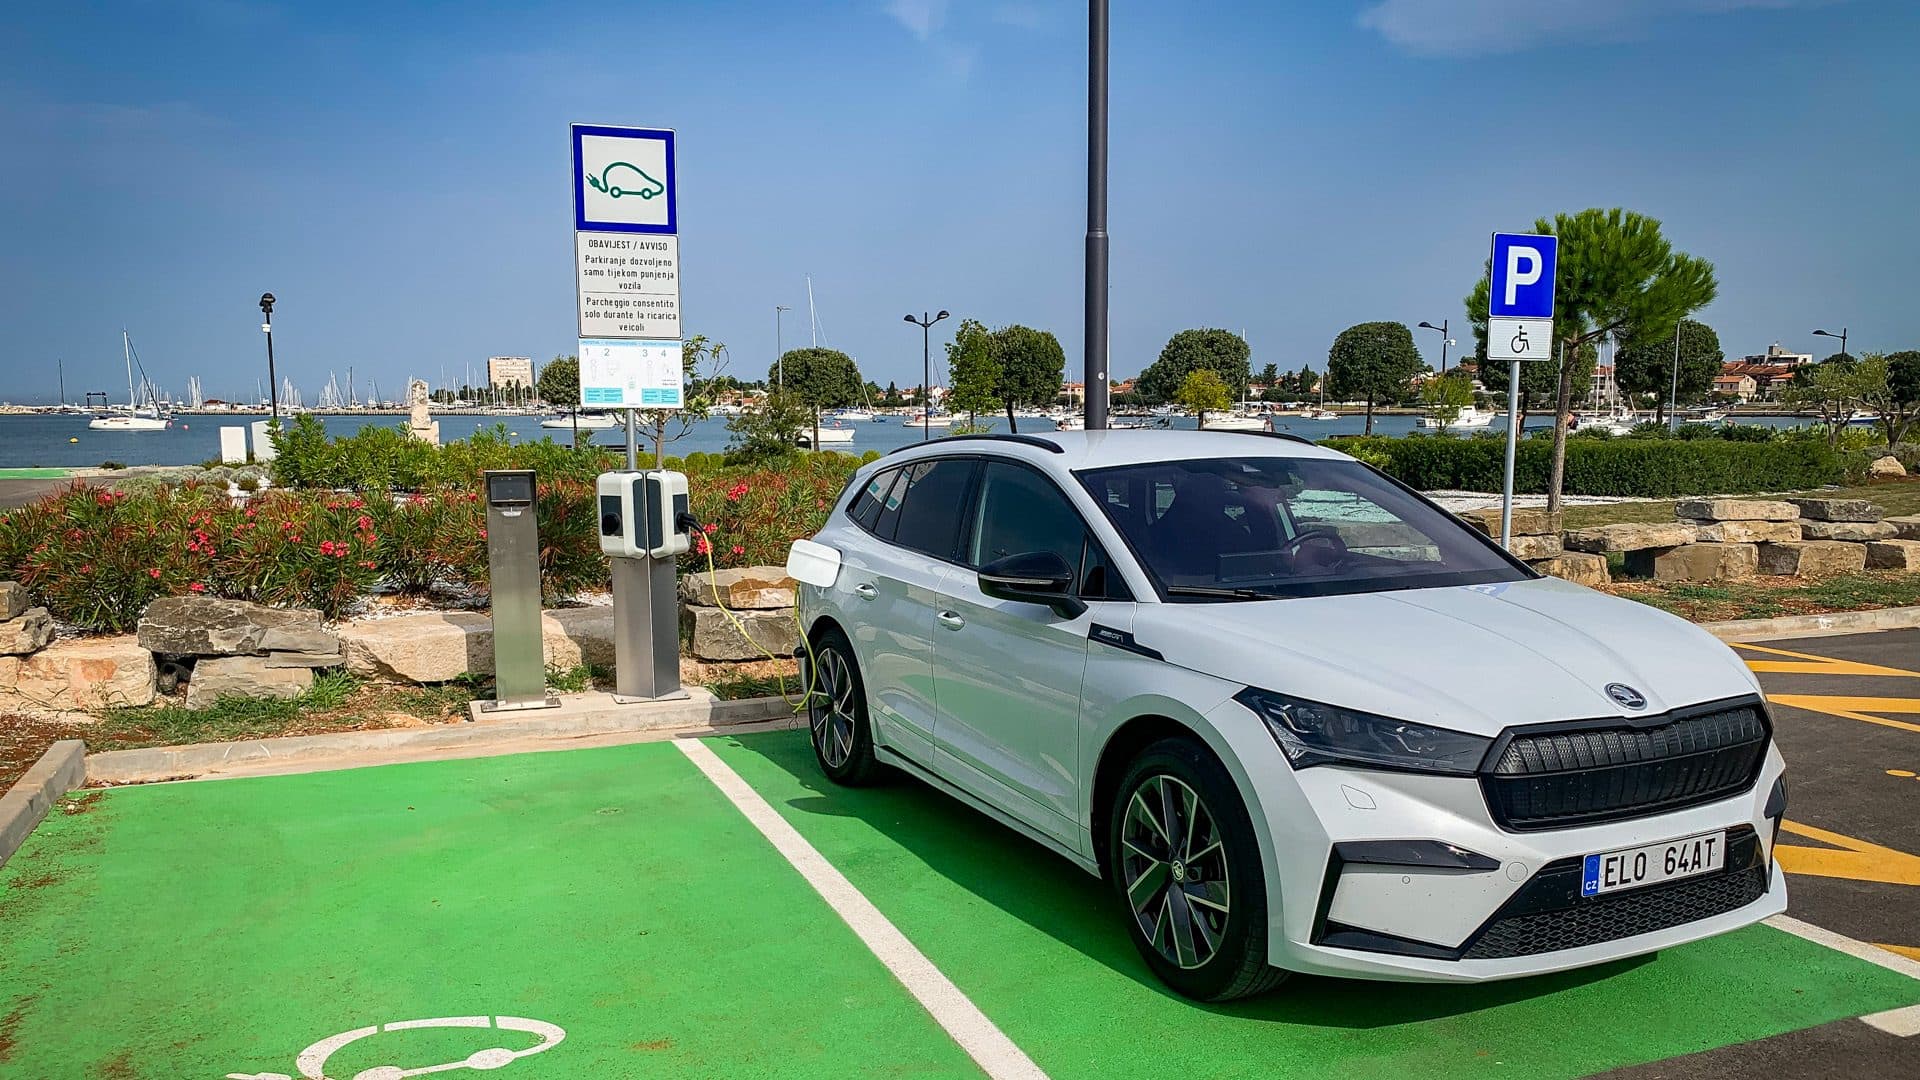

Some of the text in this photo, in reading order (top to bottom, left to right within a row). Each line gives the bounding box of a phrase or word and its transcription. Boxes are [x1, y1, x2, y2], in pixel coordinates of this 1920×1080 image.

[588, 240, 668, 251] OBAVIJEST / AVVISO
[585, 254, 672, 268] Parkiranje dozvoljeno
[608, 269, 638, 279] tijekom
[640, 271, 674, 280] punjenja
[1505, 245, 1542, 305] P
[618, 282, 642, 290] vozila
[586, 297, 674, 308] Parcheggio consentito
[584, 310, 677, 320] solo durante la ricarica
[618, 324, 645, 332] veicoli
[585, 348, 667, 358] 1 2 3 4
[1664, 838, 1716, 875] 64AT
[1585, 880, 1598, 891] CZ
